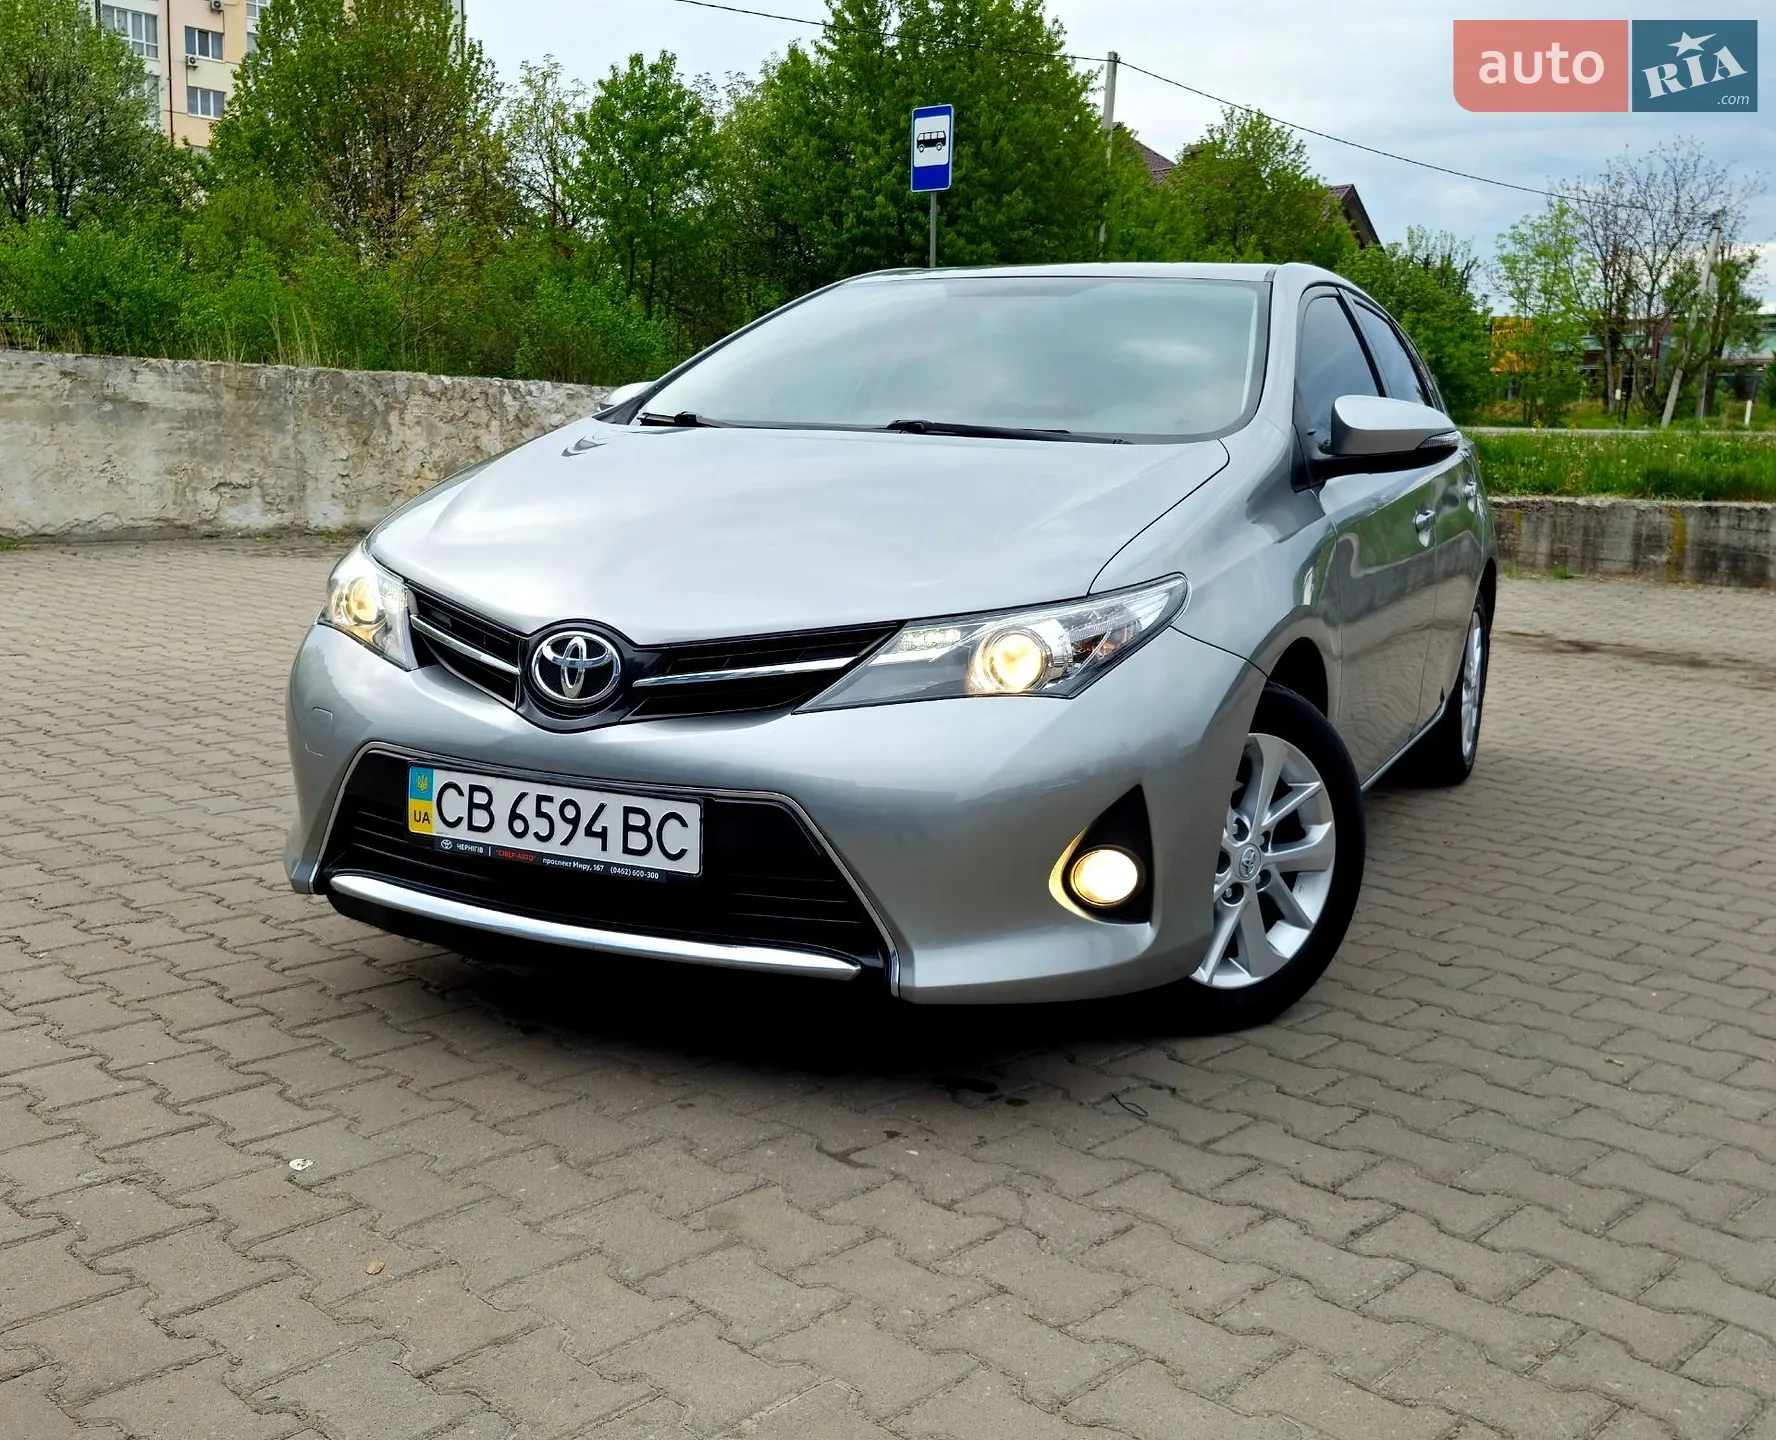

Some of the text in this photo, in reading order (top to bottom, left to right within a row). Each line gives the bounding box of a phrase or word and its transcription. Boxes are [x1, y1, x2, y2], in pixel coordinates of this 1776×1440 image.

[413, 810, 431, 825] UA
[436, 781, 689, 862] CB 6594 BC
